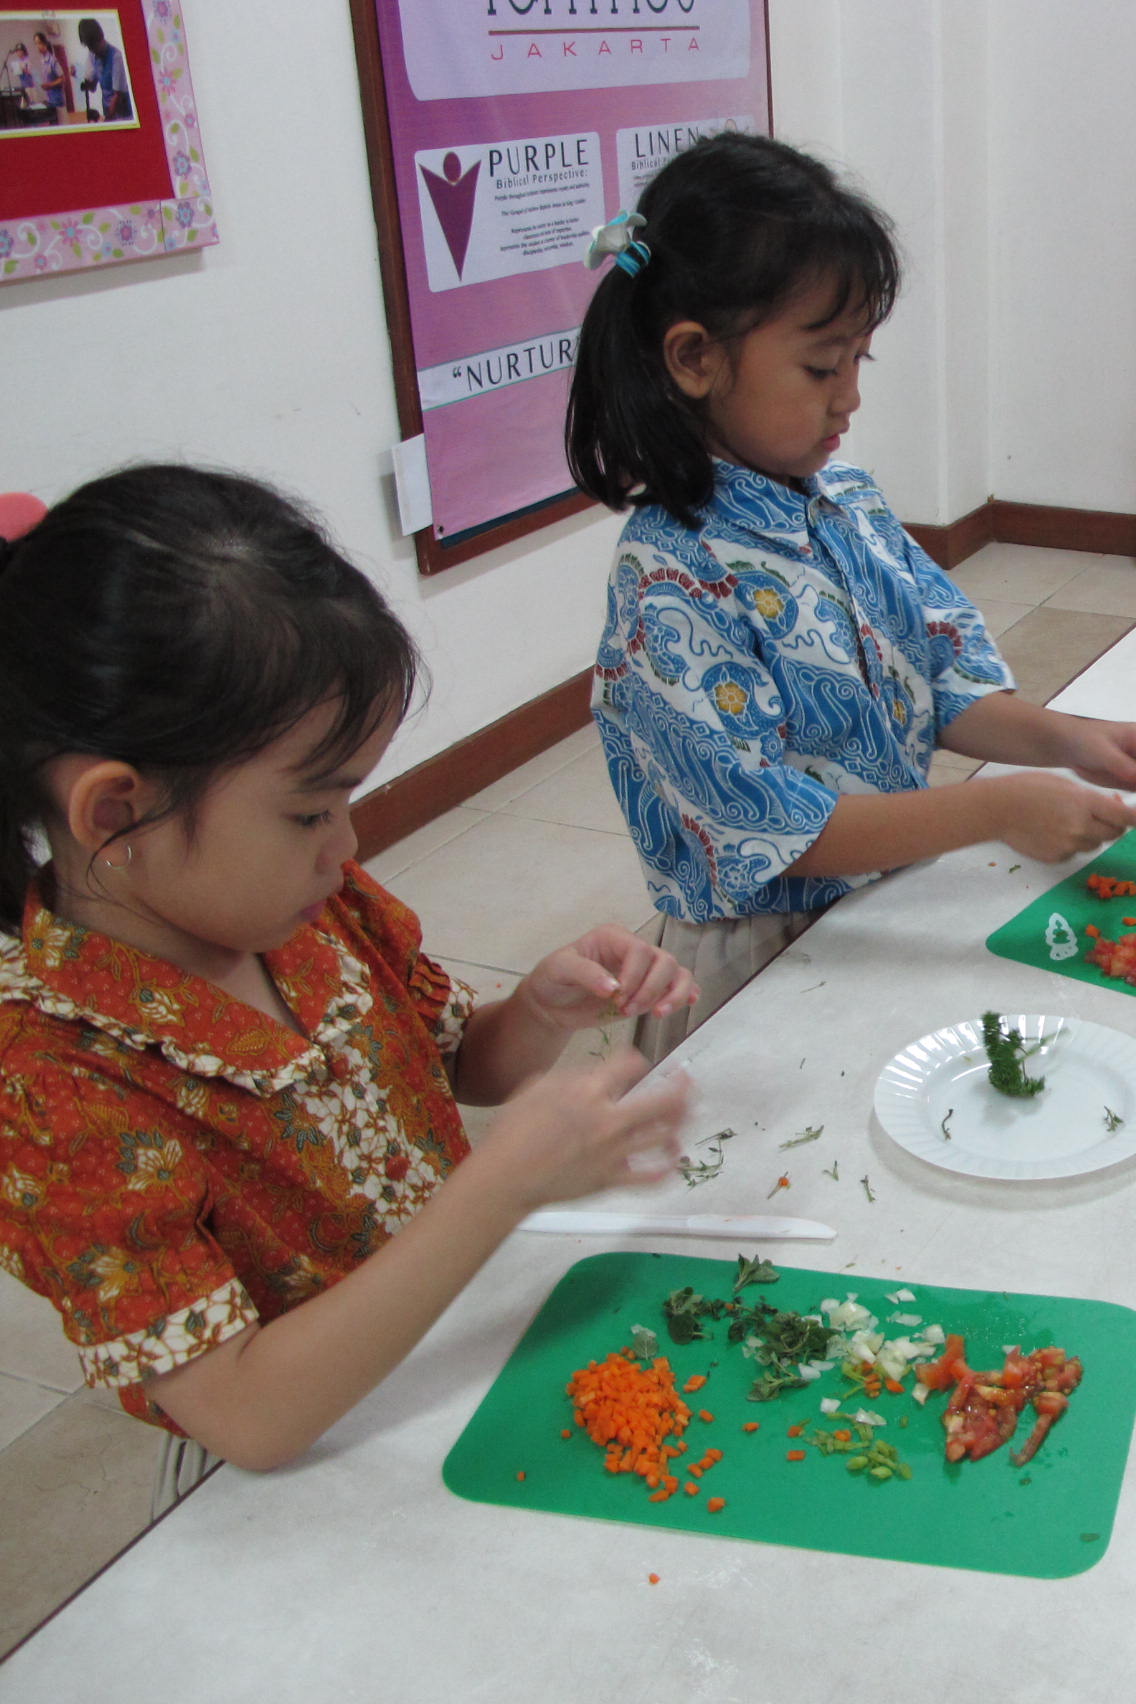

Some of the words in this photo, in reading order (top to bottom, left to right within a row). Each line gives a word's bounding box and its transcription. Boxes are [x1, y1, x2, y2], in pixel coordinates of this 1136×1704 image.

[490, 37, 700, 61] JAKARTA
[489, 139, 589, 177] PURPLE
[634, 126, 700, 158] LINEN
[496, 174, 529, 190] Biblical
[452, 338, 577, 391] “NURTUR
